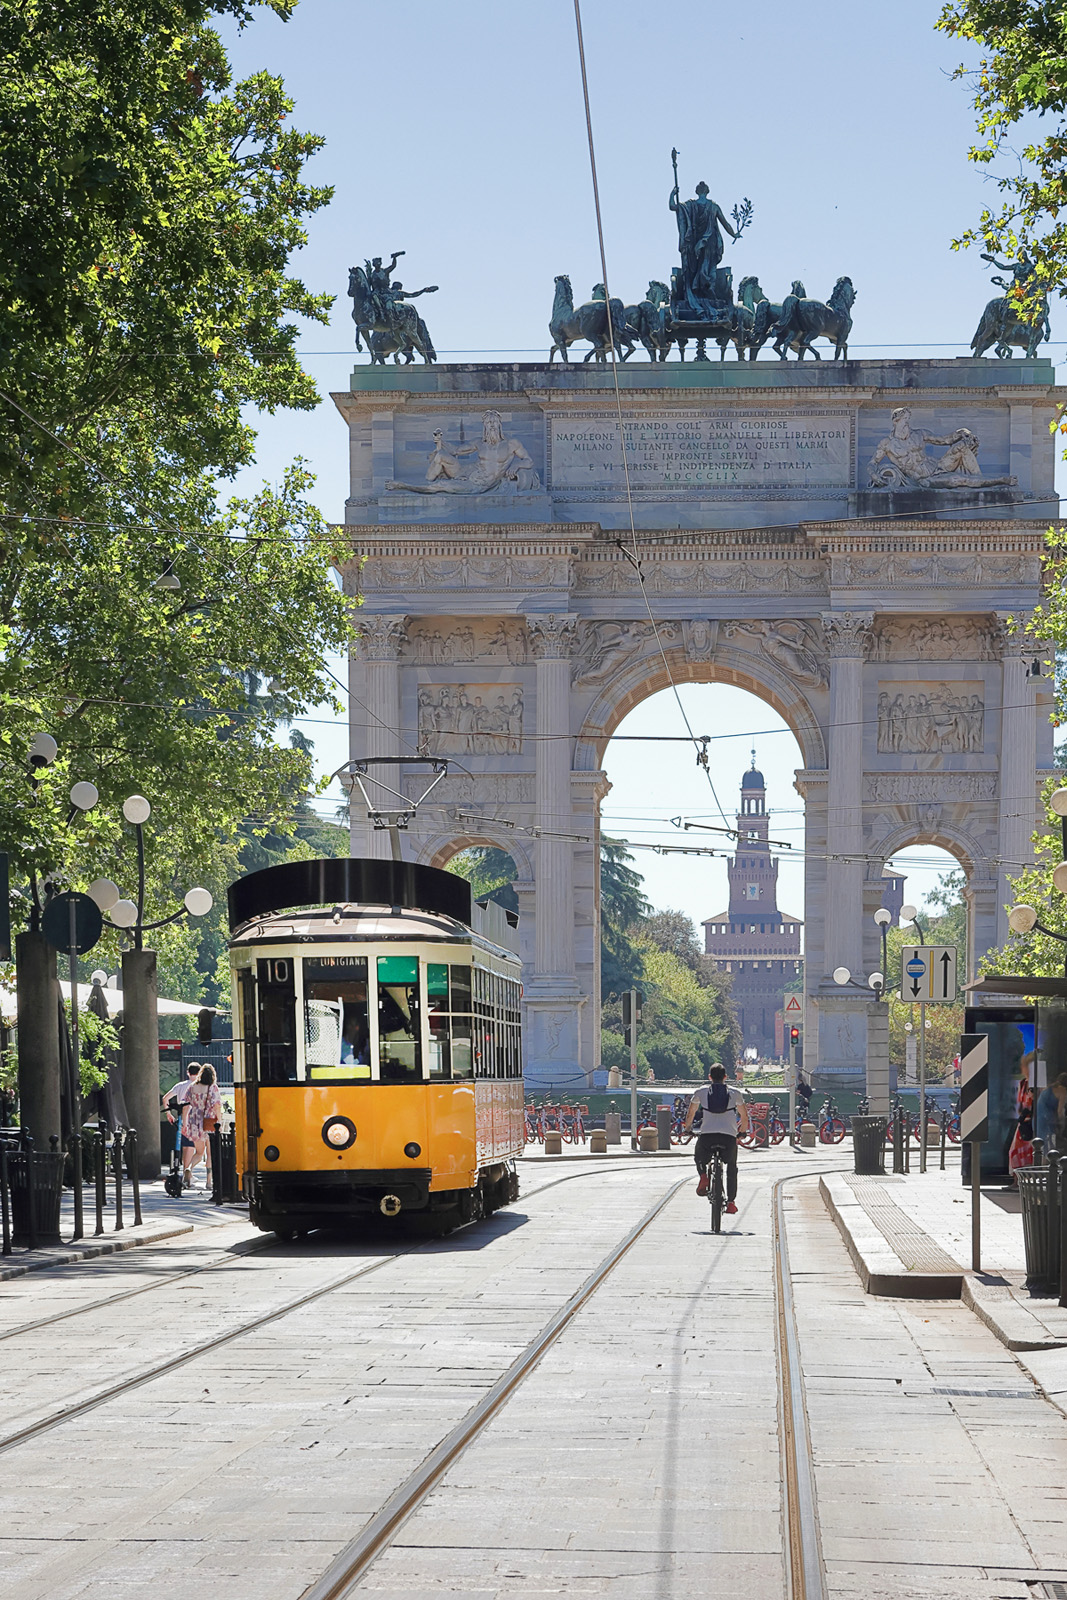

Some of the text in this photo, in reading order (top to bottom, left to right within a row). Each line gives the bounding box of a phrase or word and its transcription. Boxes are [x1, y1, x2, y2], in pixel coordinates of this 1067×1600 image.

[615, 422, 668, 431] ENTRANDO
[709, 422, 733, 430] ARMI
[741, 421, 788, 430] GLORIOSE
[556, 430, 846, 441] NAPOLEONE III E VITTORIO EMANUELE II LIBERATORI
[573, 443, 613, 452] MILANO
[736, 442, 748, 450] DA
[755, 441, 790, 450] QUESTI
[795, 440, 828, 449] MARMI
[643, 451, 758, 460] LE IMPRONTE SERVILI
[589, 463, 595, 471] E
[603, 463, 613, 471] VI
[620, 463, 659, 471] SCRISSE
[679, 461, 756, 470] INDIPENDENZA
[778, 461, 813, 470] ITALIA
[266, 959, 288, 982] 10
